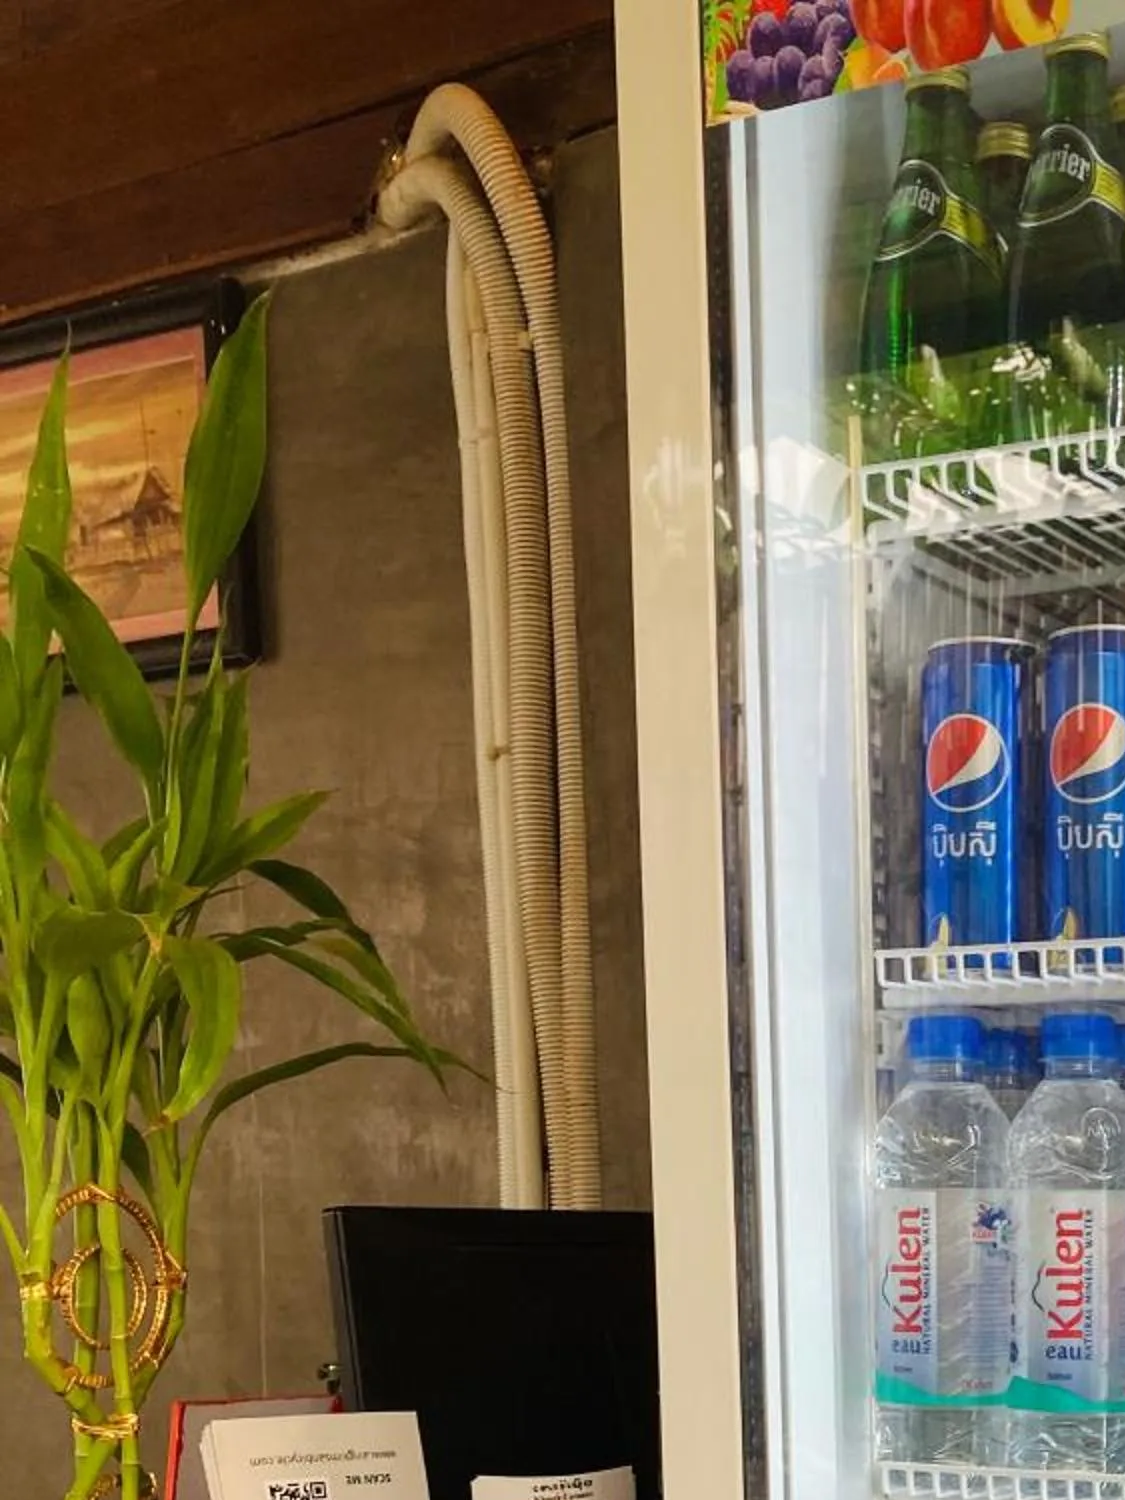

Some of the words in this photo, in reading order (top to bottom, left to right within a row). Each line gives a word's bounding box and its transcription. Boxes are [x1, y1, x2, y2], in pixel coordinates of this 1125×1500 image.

[890, 1207, 923, 1335] Kulen
[1045, 1208, 1085, 1341] Kulen
[890, 1339, 922, 1356] eau
[1045, 1344, 1083, 1361] eau
[345, 1474, 361, 1485] ME
[364, 1473, 392, 1485] SCAN
